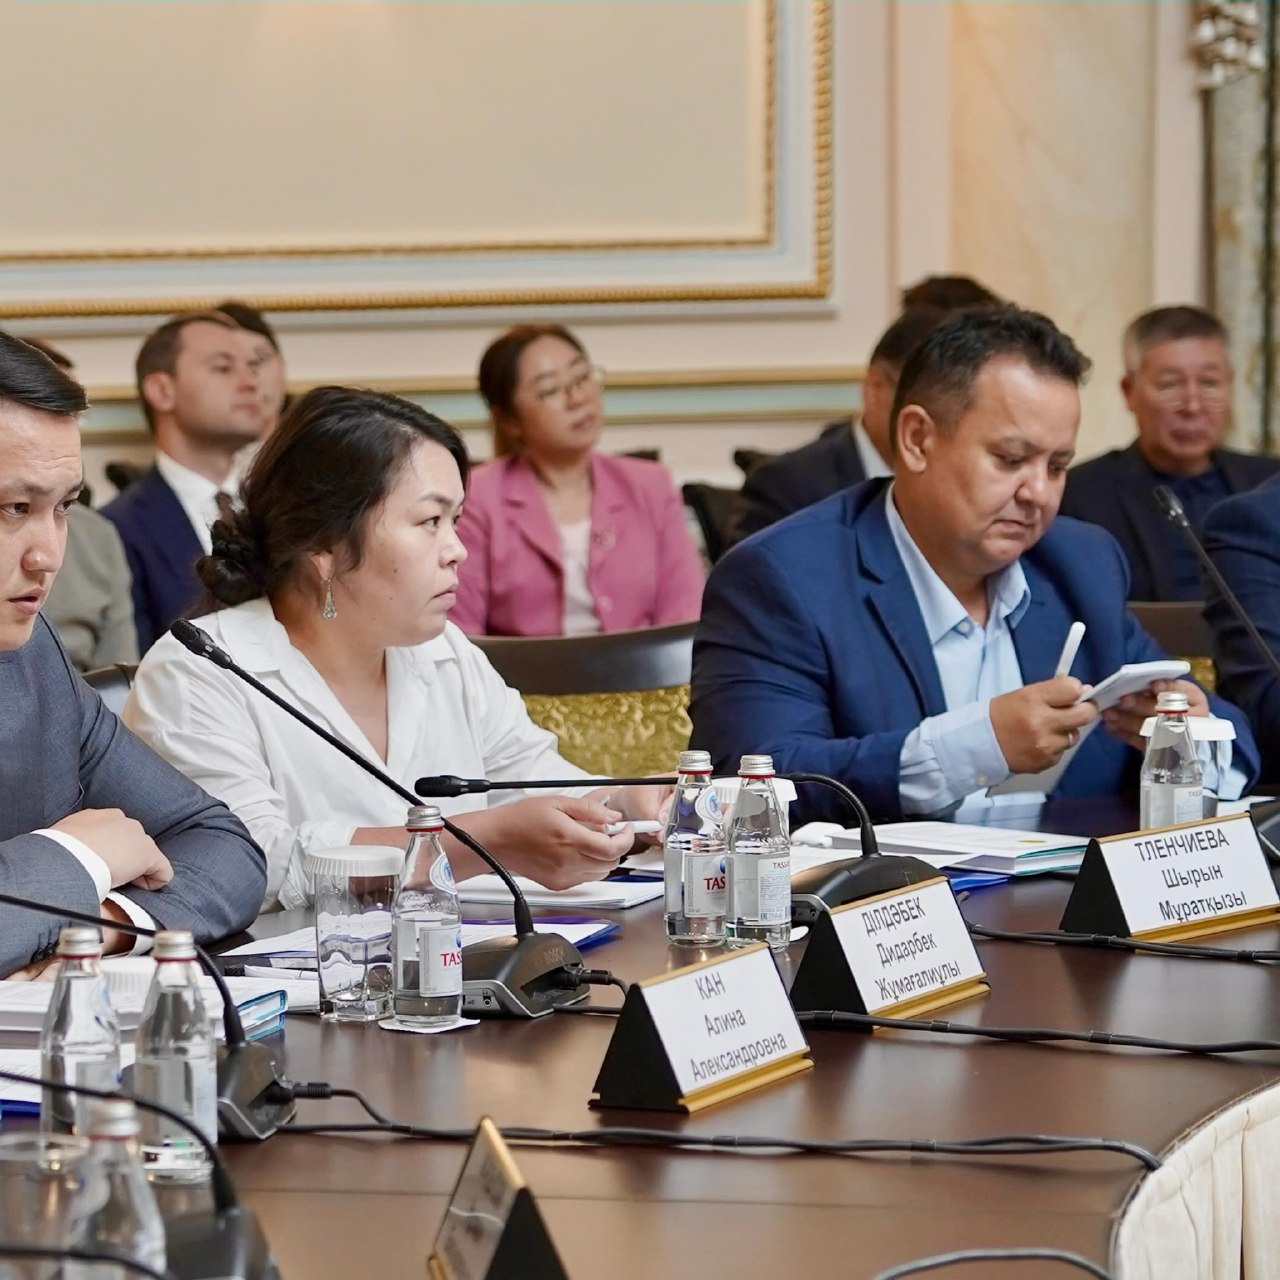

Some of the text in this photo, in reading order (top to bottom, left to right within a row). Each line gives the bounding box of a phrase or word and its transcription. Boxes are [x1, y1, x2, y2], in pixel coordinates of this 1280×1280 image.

[1134, 828, 1230, 862] ТЛЕНЧИЕВА
[1161, 864, 1223, 888] Шырын
[861, 896, 926, 938] ДІЛДӘБЕК
[1159, 891, 1248, 923] Мұратқызы
[876, 931, 938, 969] Дидарбек
[695, 971, 726, 1001] КАН
[875, 960, 962, 1002] Жұмағалиұлы
[704, 1009, 746, 1038] Алина
[690, 1032, 788, 1082] Александровна
